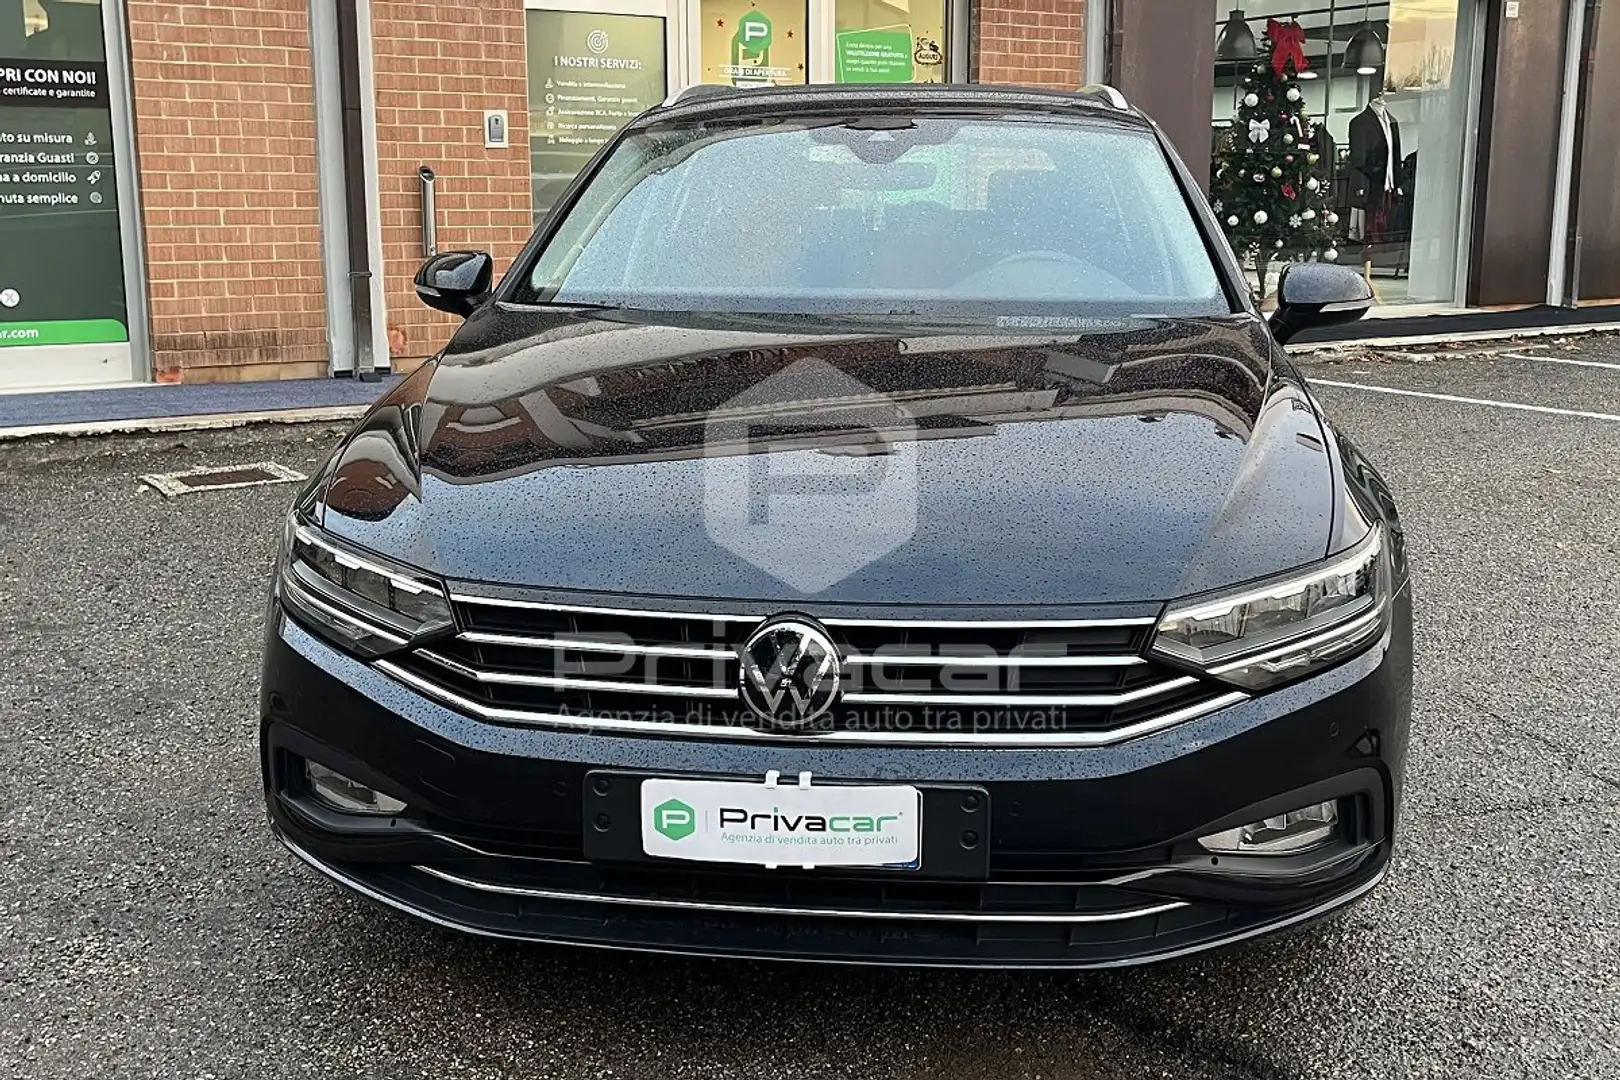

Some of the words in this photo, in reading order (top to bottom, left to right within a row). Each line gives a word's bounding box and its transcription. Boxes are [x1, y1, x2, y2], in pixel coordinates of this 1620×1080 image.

[554, 56, 558, 66] I
[560, 56, 599, 68] NOSTRI
[600, 58, 642, 70] SERVIZI:
[24, 68, 60, 84] CON
[62, 70, 96, 84] NOI!
[753, 69, 787, 77] APERTURA
[2, 86, 47, 96] certificate
[48, 89, 54, 97] e
[56, 88, 96, 98] garantite
[17, 133, 30, 143] su
[33, 132, 73, 144] misura
[37, 152, 75, 163] Guasti
[12, 174, 20, 182] a
[22, 171, 77, 183] domicilio
[26, 192, 78, 206] semplice
[719, 806, 899, 832] Privacar
[721, 832, 762, 844] Agenzia
[764, 833, 775, 844] di
[777, 834, 818, 845] vendita
[820, 835, 845, 845] auto
[847, 836, 862, 845] tra
[864, 836, 898, 846] privati
